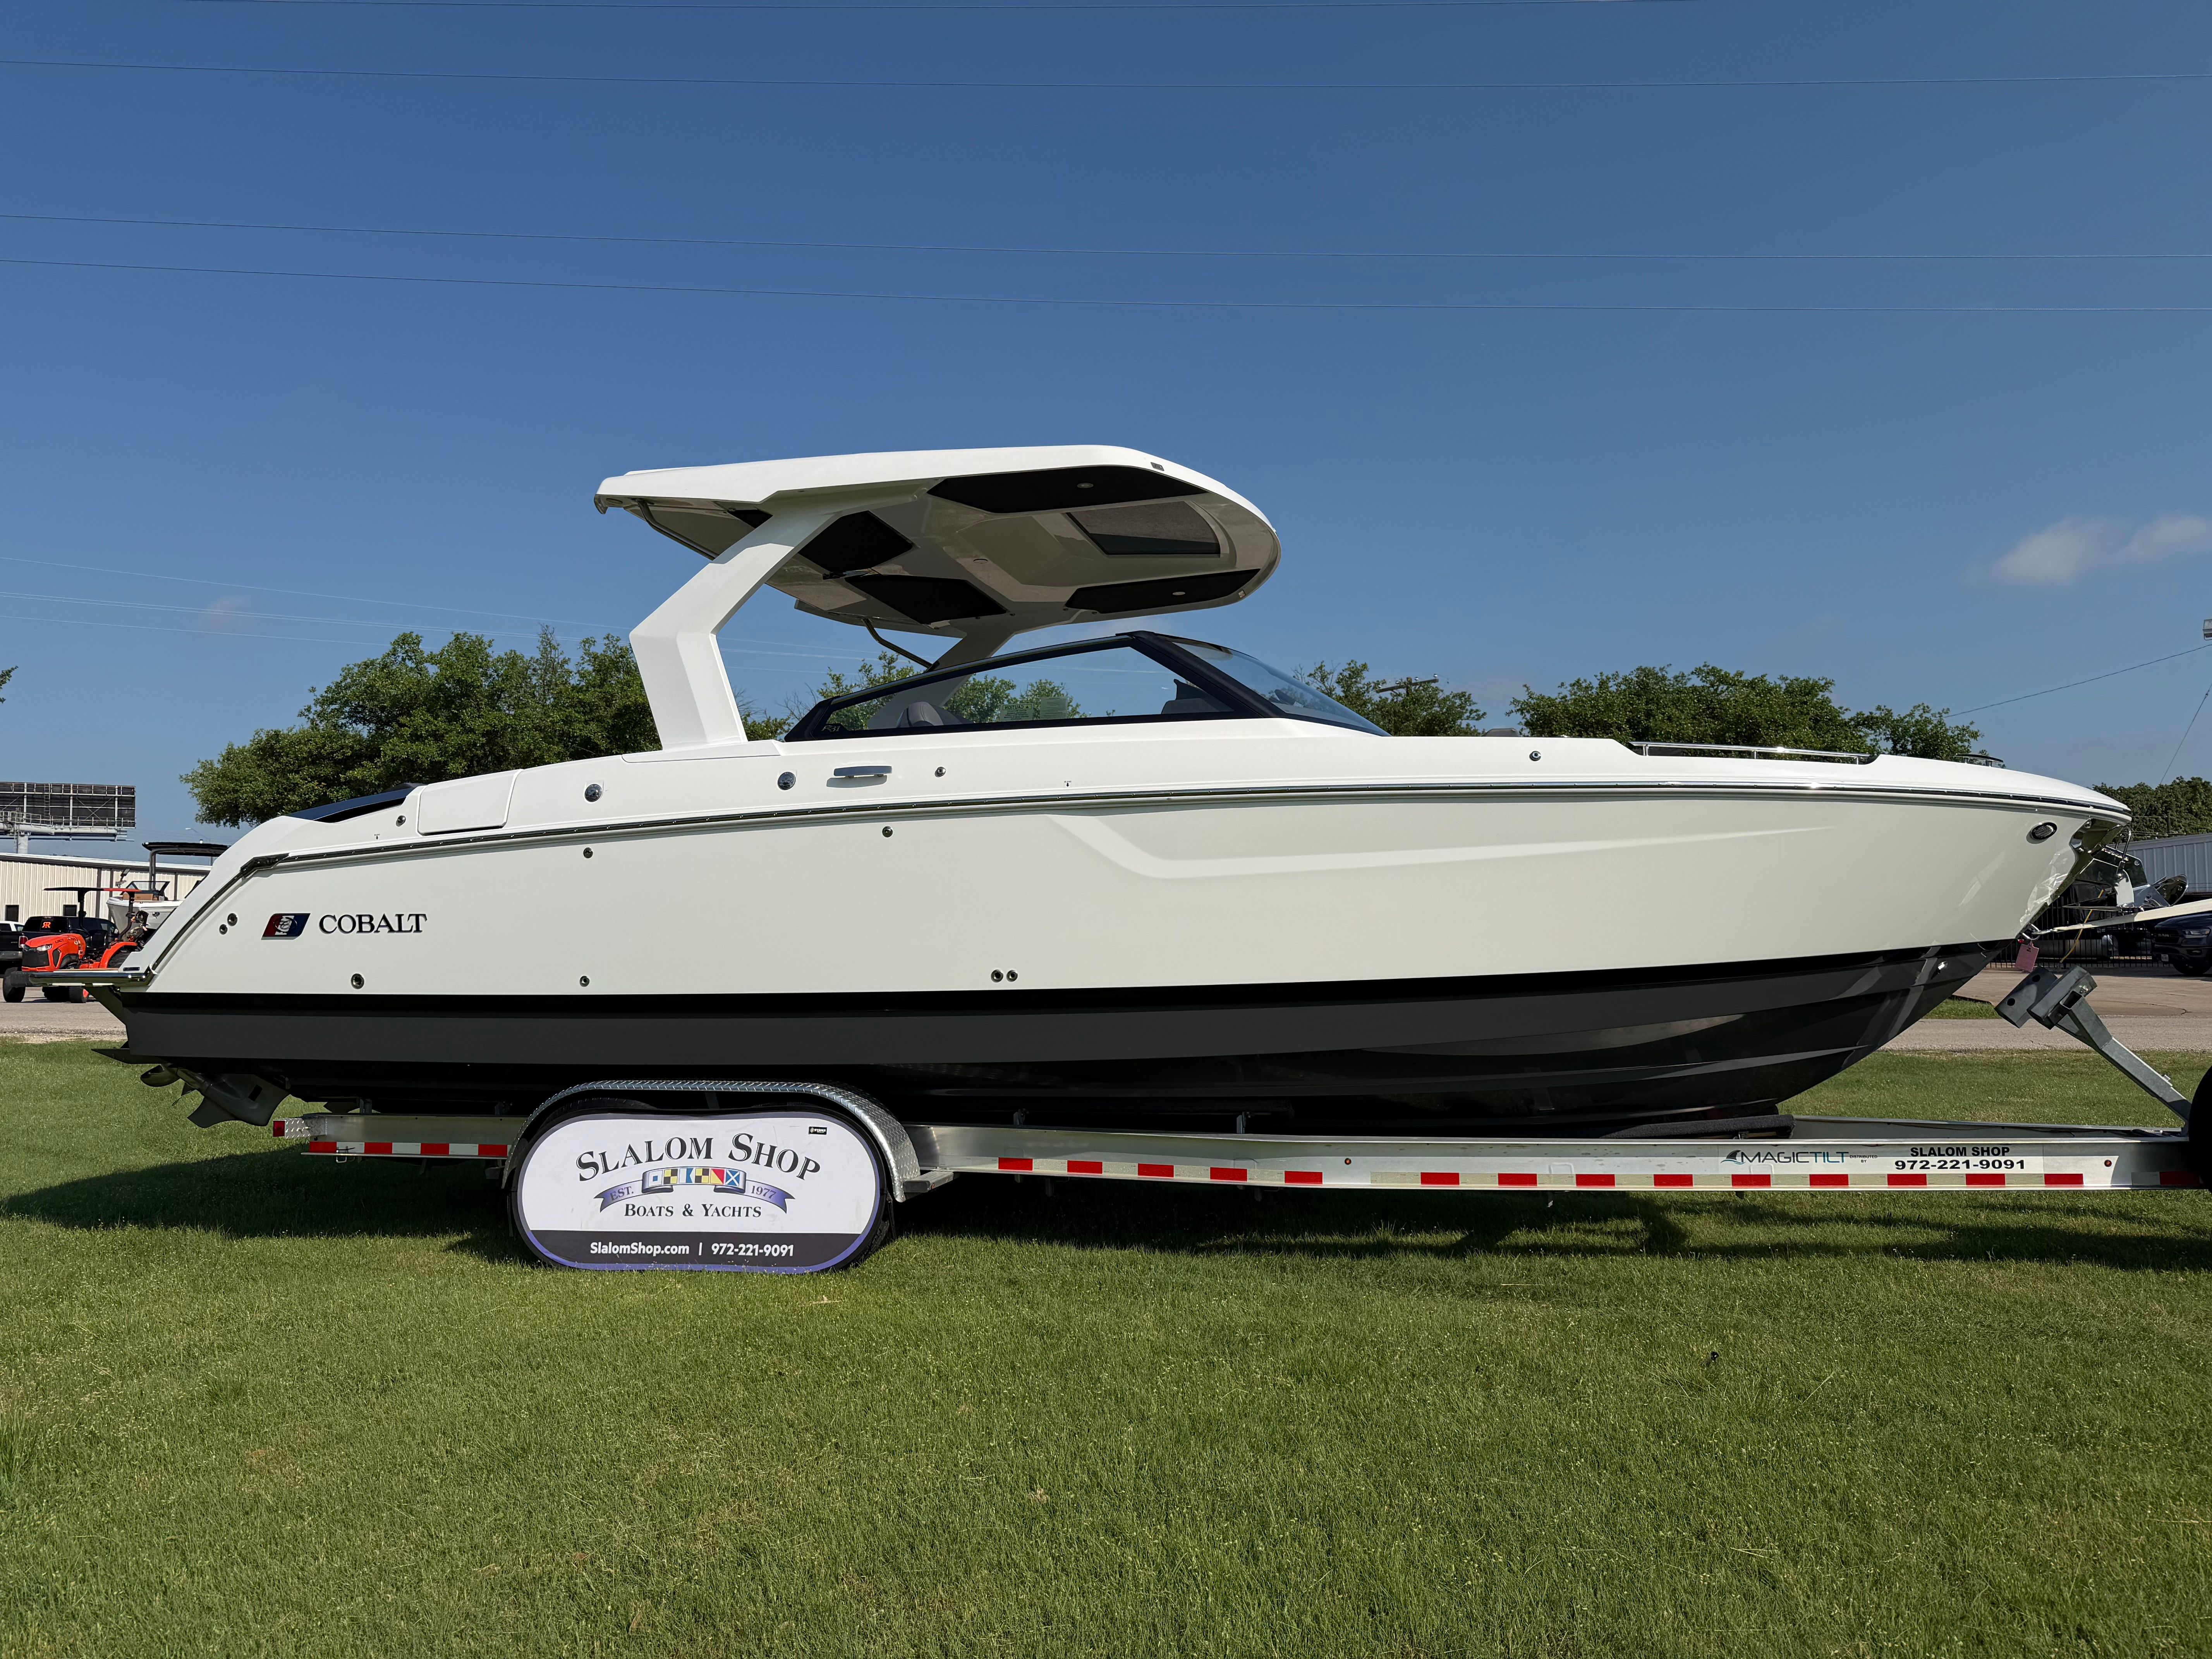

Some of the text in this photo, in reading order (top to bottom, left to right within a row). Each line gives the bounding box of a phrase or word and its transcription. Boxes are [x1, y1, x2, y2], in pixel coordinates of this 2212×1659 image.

[319, 913, 428, 934] COBALT
[576, 1133, 821, 1182] SLALOM SHOP
[1741, 1151, 1849, 1163] MAGICTILT
[1910, 1147, 2010, 1157] SLALOM SHOP
[1894, 1159, 2025, 1170] 972-221-9091
[610, 1185, 777, 1201] EST. 1977
[624, 1203, 762, 1218] BOATS & YACHTS
[590, 1242, 690, 1256] SlalomShop.com
[711, 1243, 794, 1256] 972-221-9091
